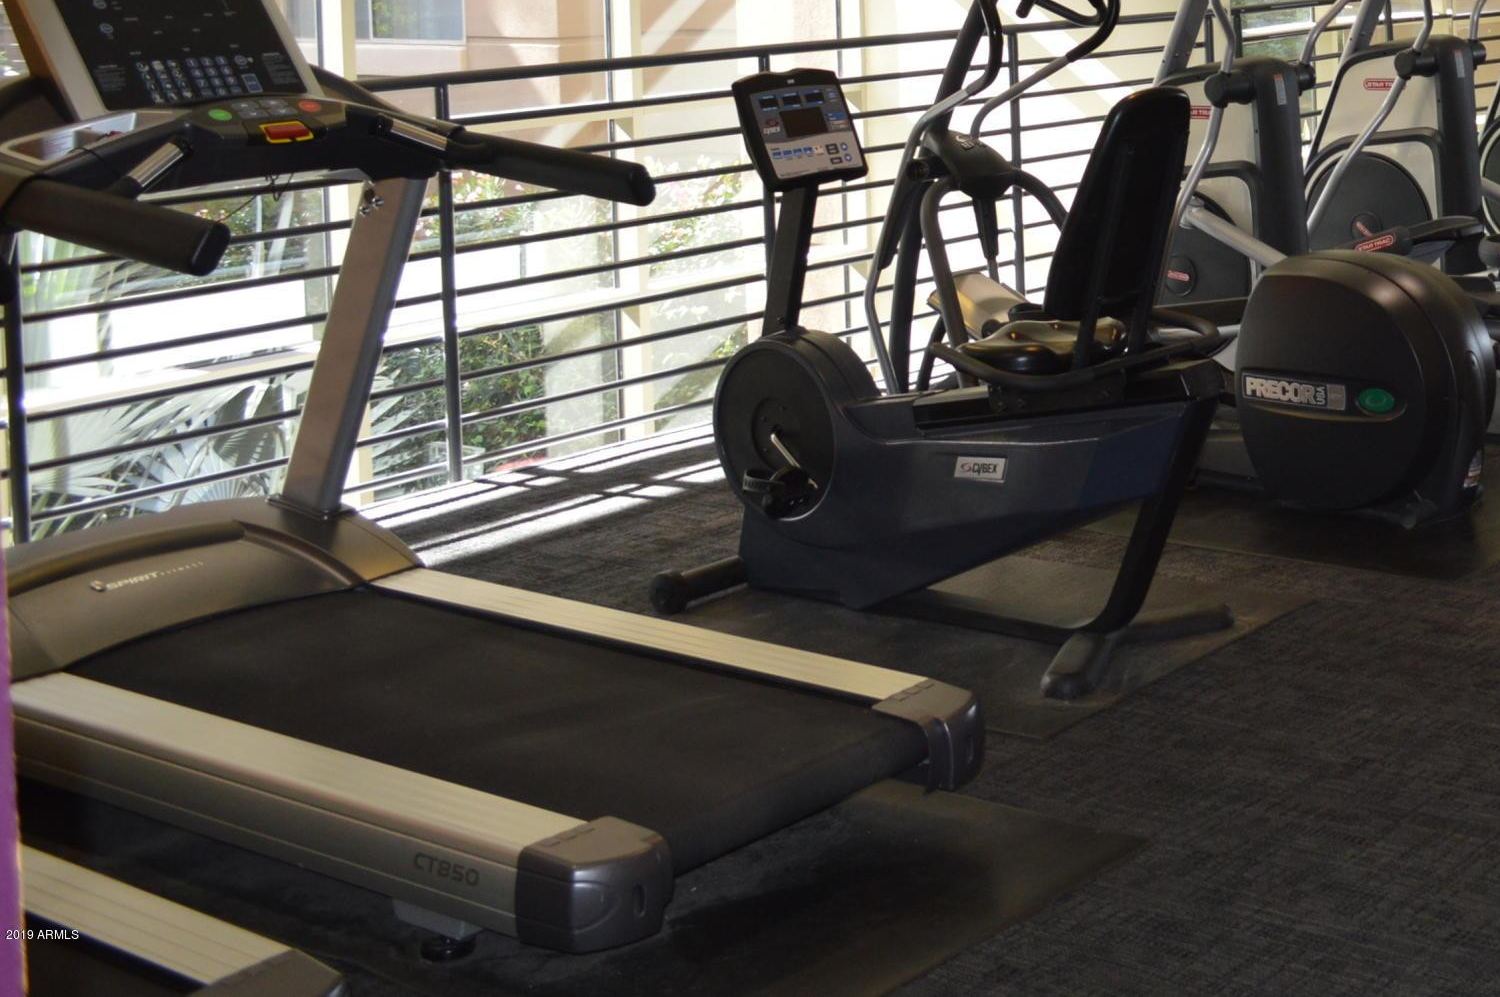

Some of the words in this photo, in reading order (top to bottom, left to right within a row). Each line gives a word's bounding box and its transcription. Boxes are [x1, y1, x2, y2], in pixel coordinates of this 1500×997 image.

[1245, 376, 1316, 405] PRECOR
[1315, 386, 1326, 406] USA
[972, 463, 997, 475] CYBEX
[106, 571, 159, 590] SPIRIT
[414, 852, 480, 887] CT850
